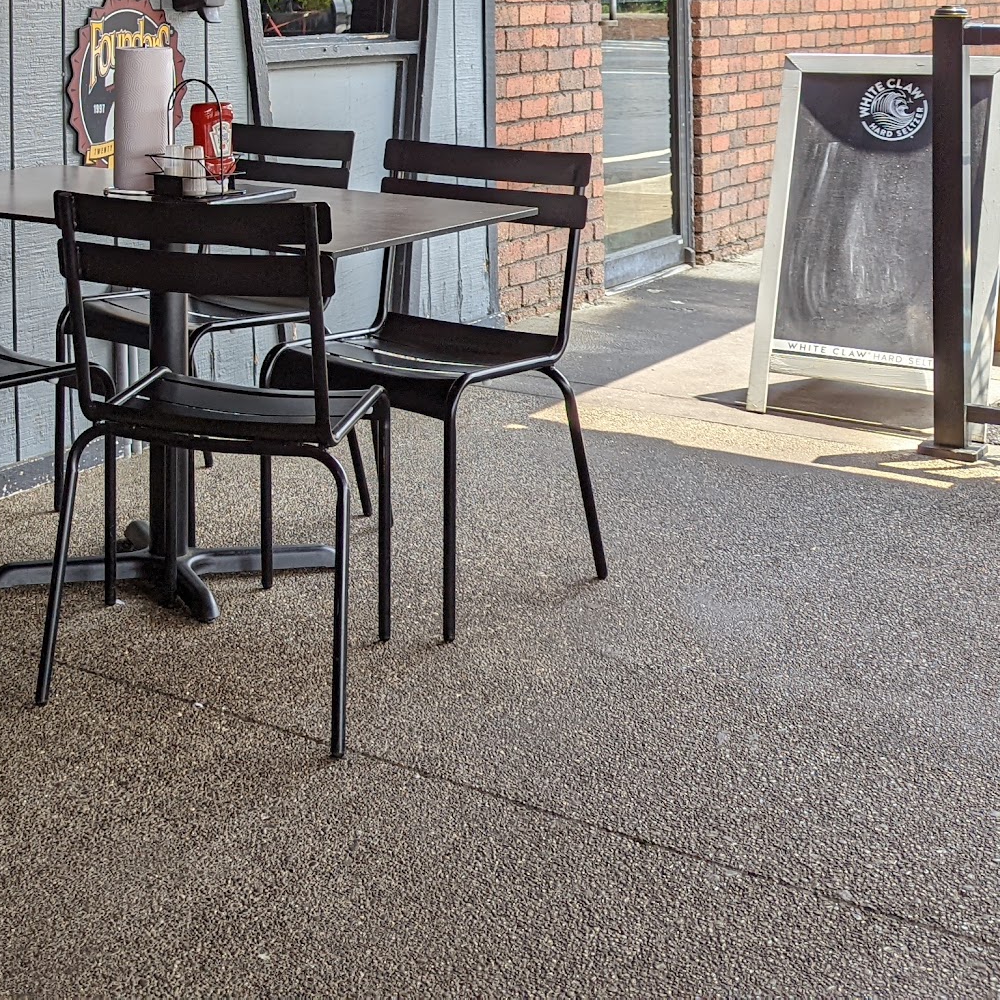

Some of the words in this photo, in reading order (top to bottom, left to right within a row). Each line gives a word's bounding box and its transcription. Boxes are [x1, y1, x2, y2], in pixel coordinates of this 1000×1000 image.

[93, 103, 106, 114] 1997
[859, 81, 885, 118] WHITE
[886, 78, 925, 99] CLAW
[869, 123, 893, 137] HARD
[895, 107, 924, 137] SELTZER
[787, 342, 826, 354] WHITE
[833, 347, 867, 358] CLAW
[873, 352, 902, 363] HARD
[908, 356, 933, 367] SELT
